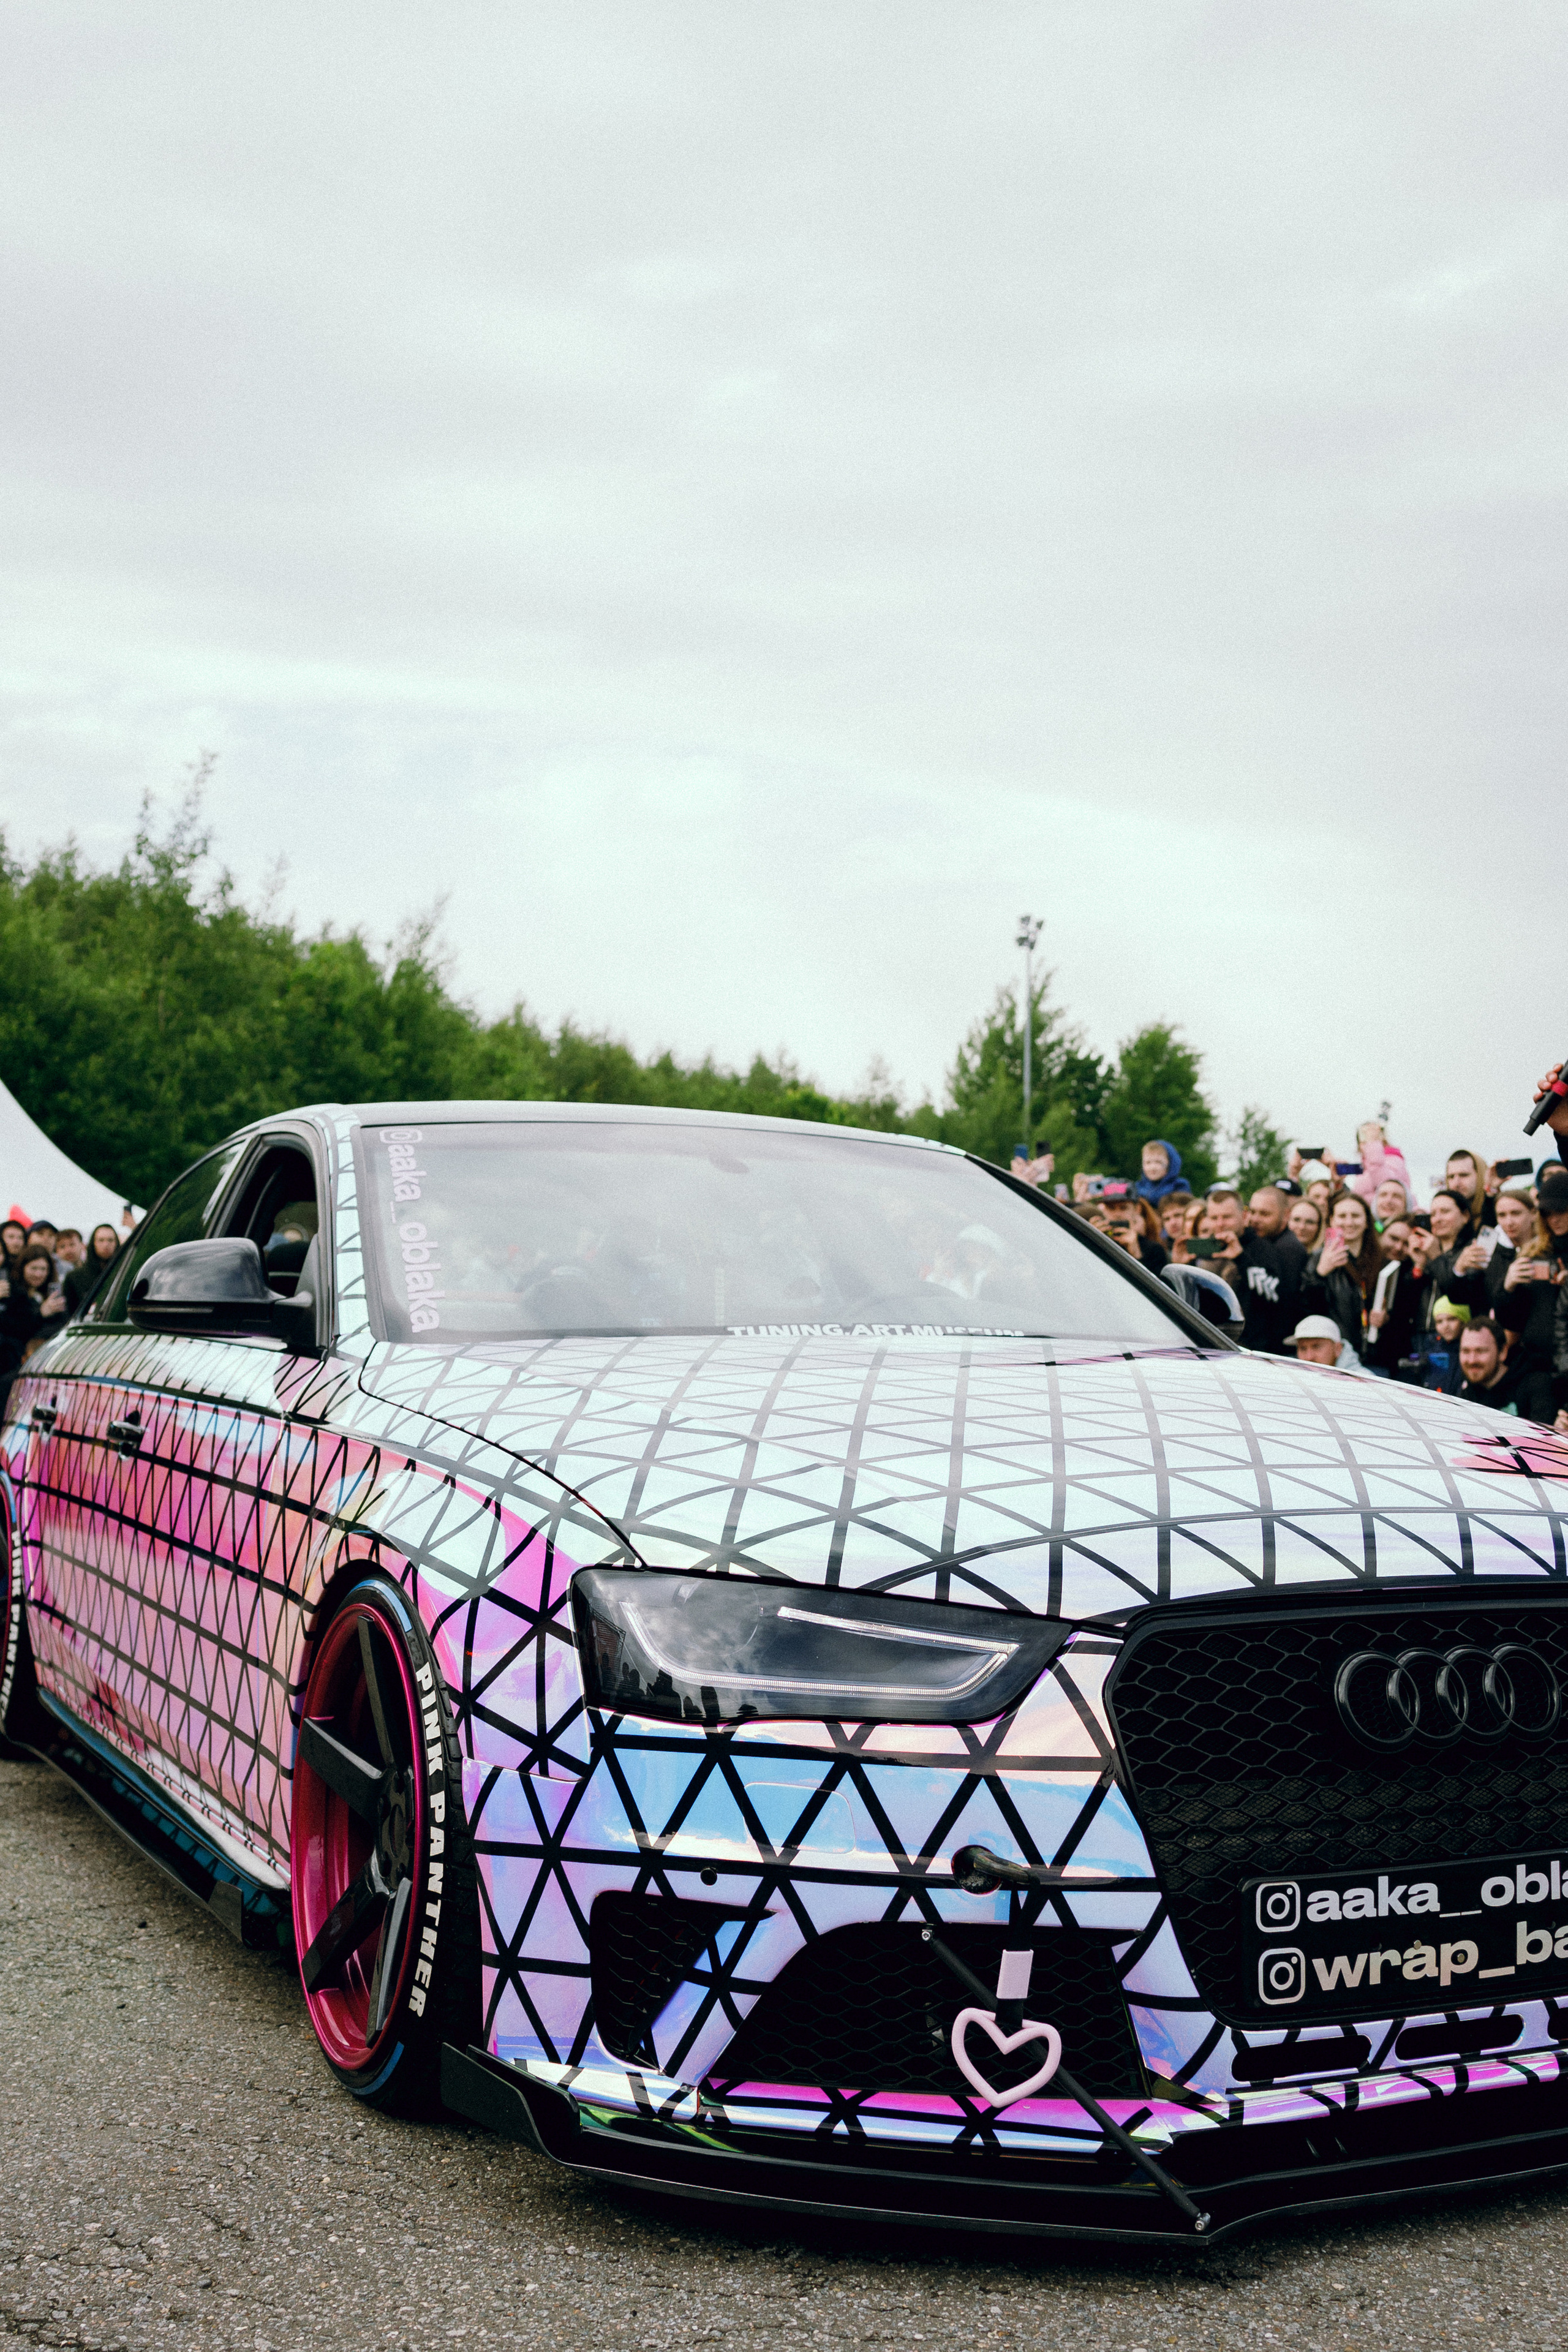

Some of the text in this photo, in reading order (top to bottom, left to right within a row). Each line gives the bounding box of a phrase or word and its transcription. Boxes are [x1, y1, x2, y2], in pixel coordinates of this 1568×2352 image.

[408, 1661, 445, 2018] PINK PANTHER
[1306, 1860, 1568, 1922] aaka__obl
